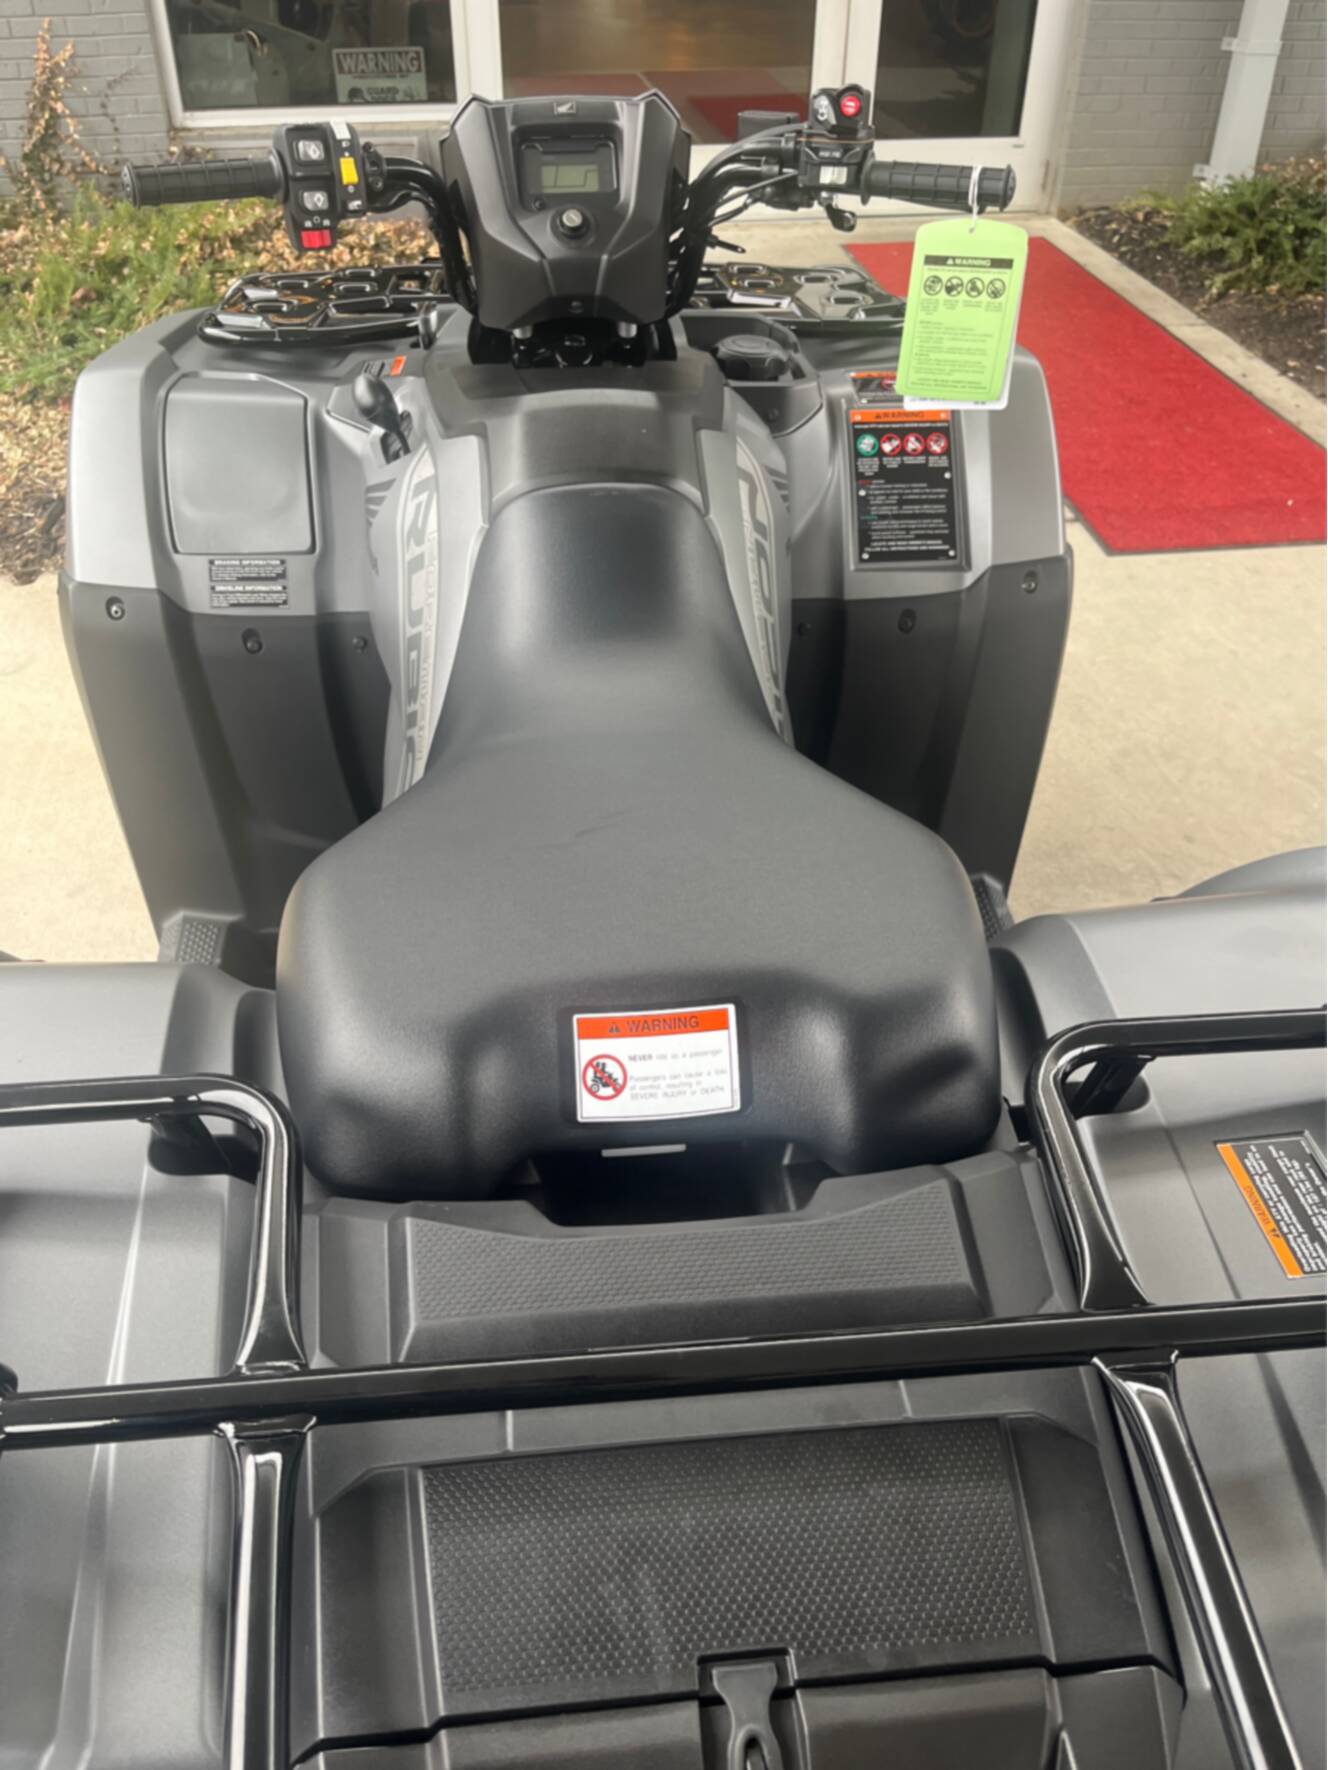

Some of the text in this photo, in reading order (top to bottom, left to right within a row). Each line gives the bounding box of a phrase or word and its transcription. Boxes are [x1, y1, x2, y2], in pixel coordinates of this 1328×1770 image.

[339, 51, 418, 73] WARNING
[954, 258, 991, 267] WARNING
[627, 1016, 700, 1032] WARNING
[628, 1053, 653, 1062] NEVER
[1241, 1185, 1270, 1223] WARNING
